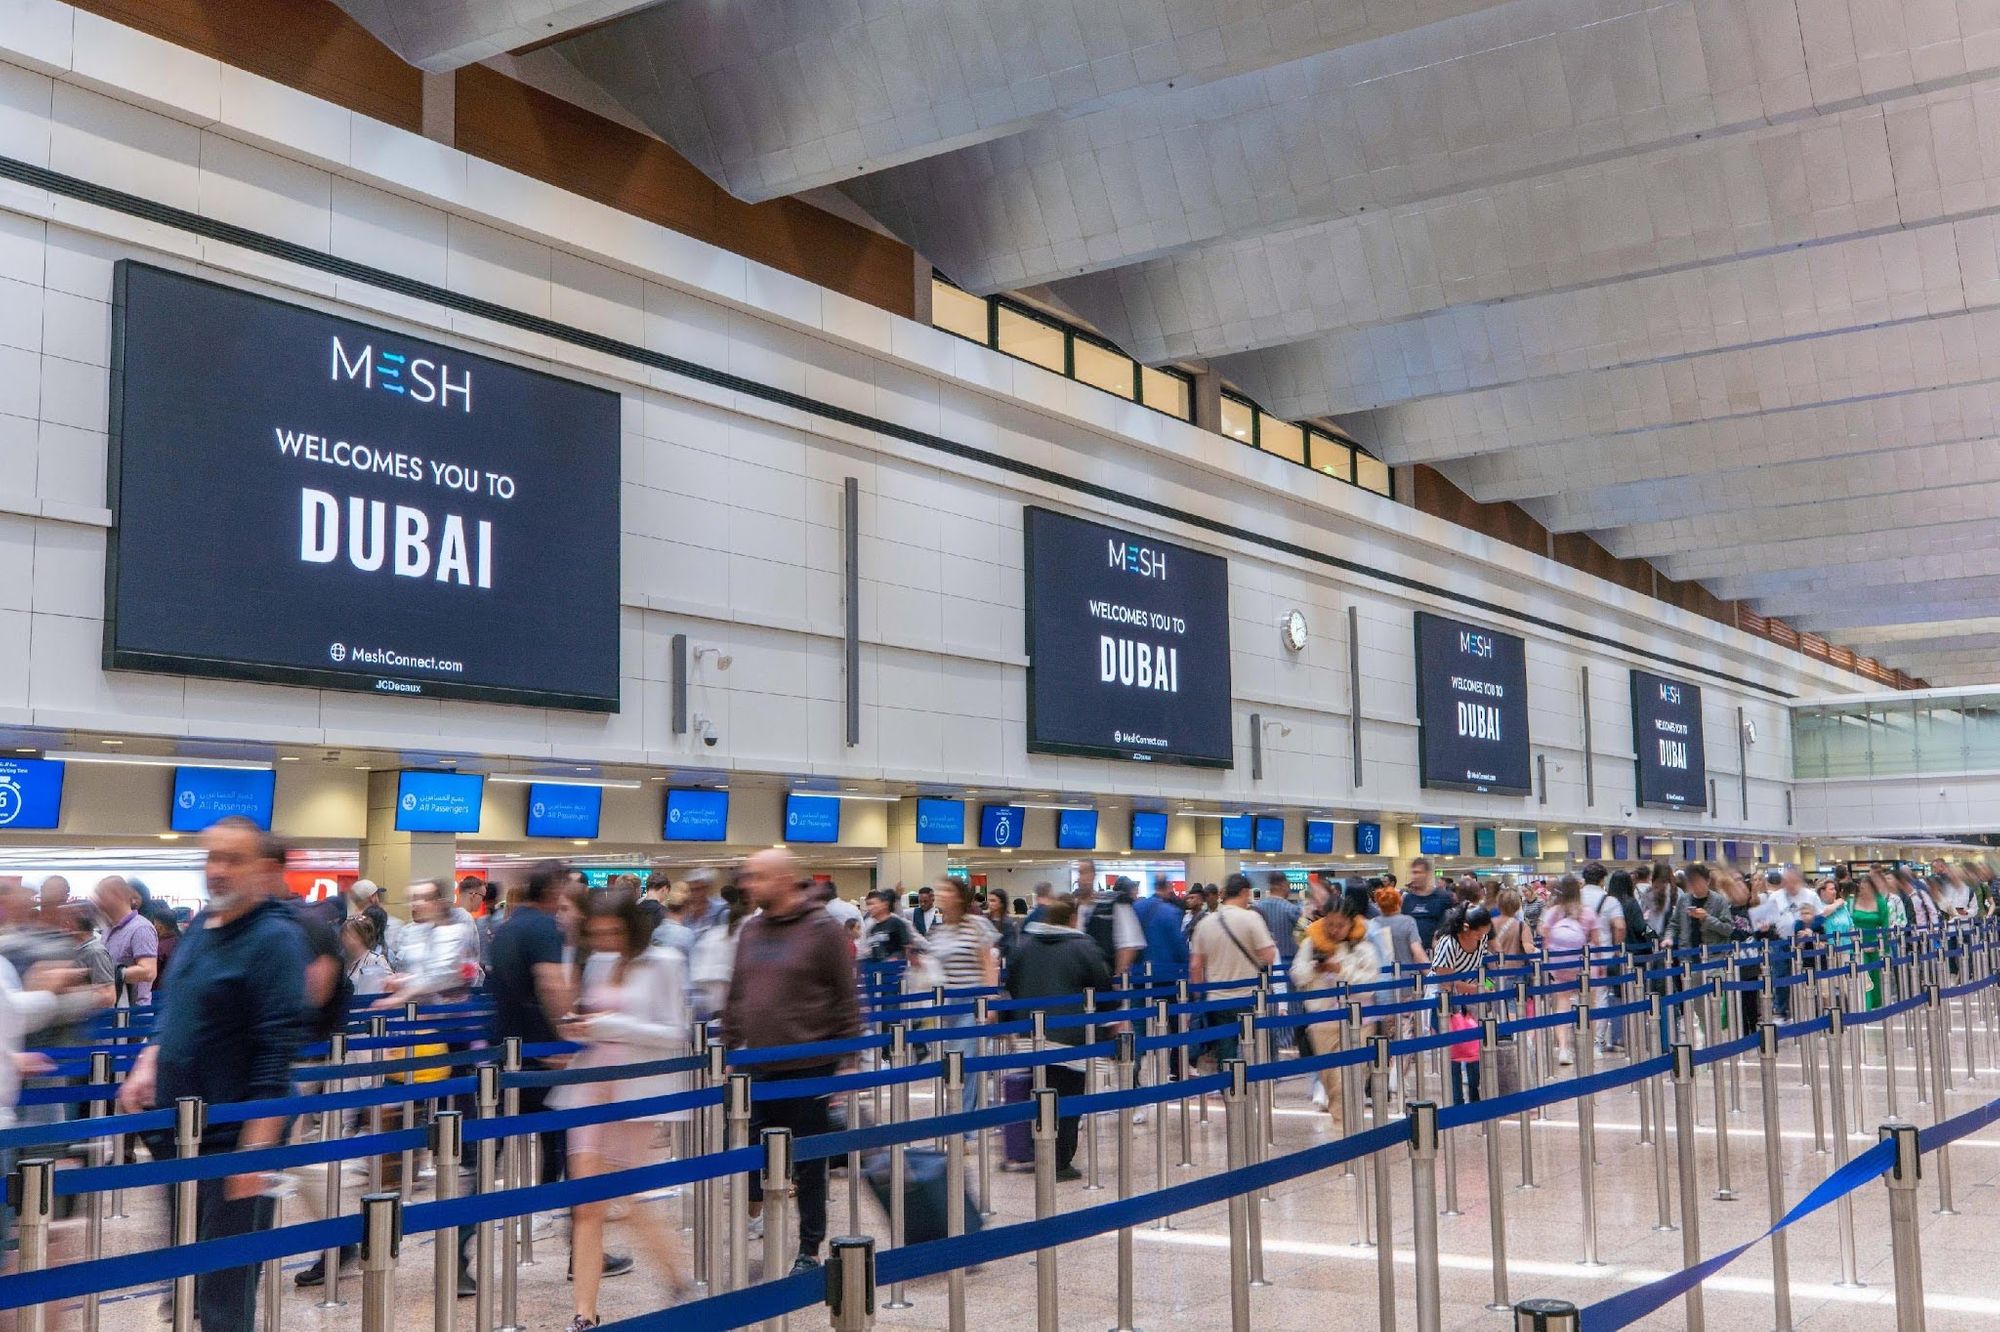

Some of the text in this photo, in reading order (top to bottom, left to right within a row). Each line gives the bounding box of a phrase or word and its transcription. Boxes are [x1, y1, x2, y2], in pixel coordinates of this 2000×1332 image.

[331, 336, 471, 412] MESH
[276, 428, 516, 499] WELCOMES YOU TO
[301, 487, 493, 588] DUBAI
[1108, 539, 1167, 580] MESH
[1089, 600, 1186, 634] WELCOMES YOU TO
[351, 647, 463, 672] MeshConnect.com
[1460, 631, 1492, 658] MESH
[1100, 635, 1178, 692] DUBAI
[375, 680, 421, 693] JCDecaux
[1451, 675, 1503, 698] WELCOMES YOU TO
[1660, 683, 1680, 705] MESH
[1458, 702, 1500, 741] DUBAI
[1659, 739, 1687, 769] DUBAI
[419, 803, 469, 815] All Passengers
